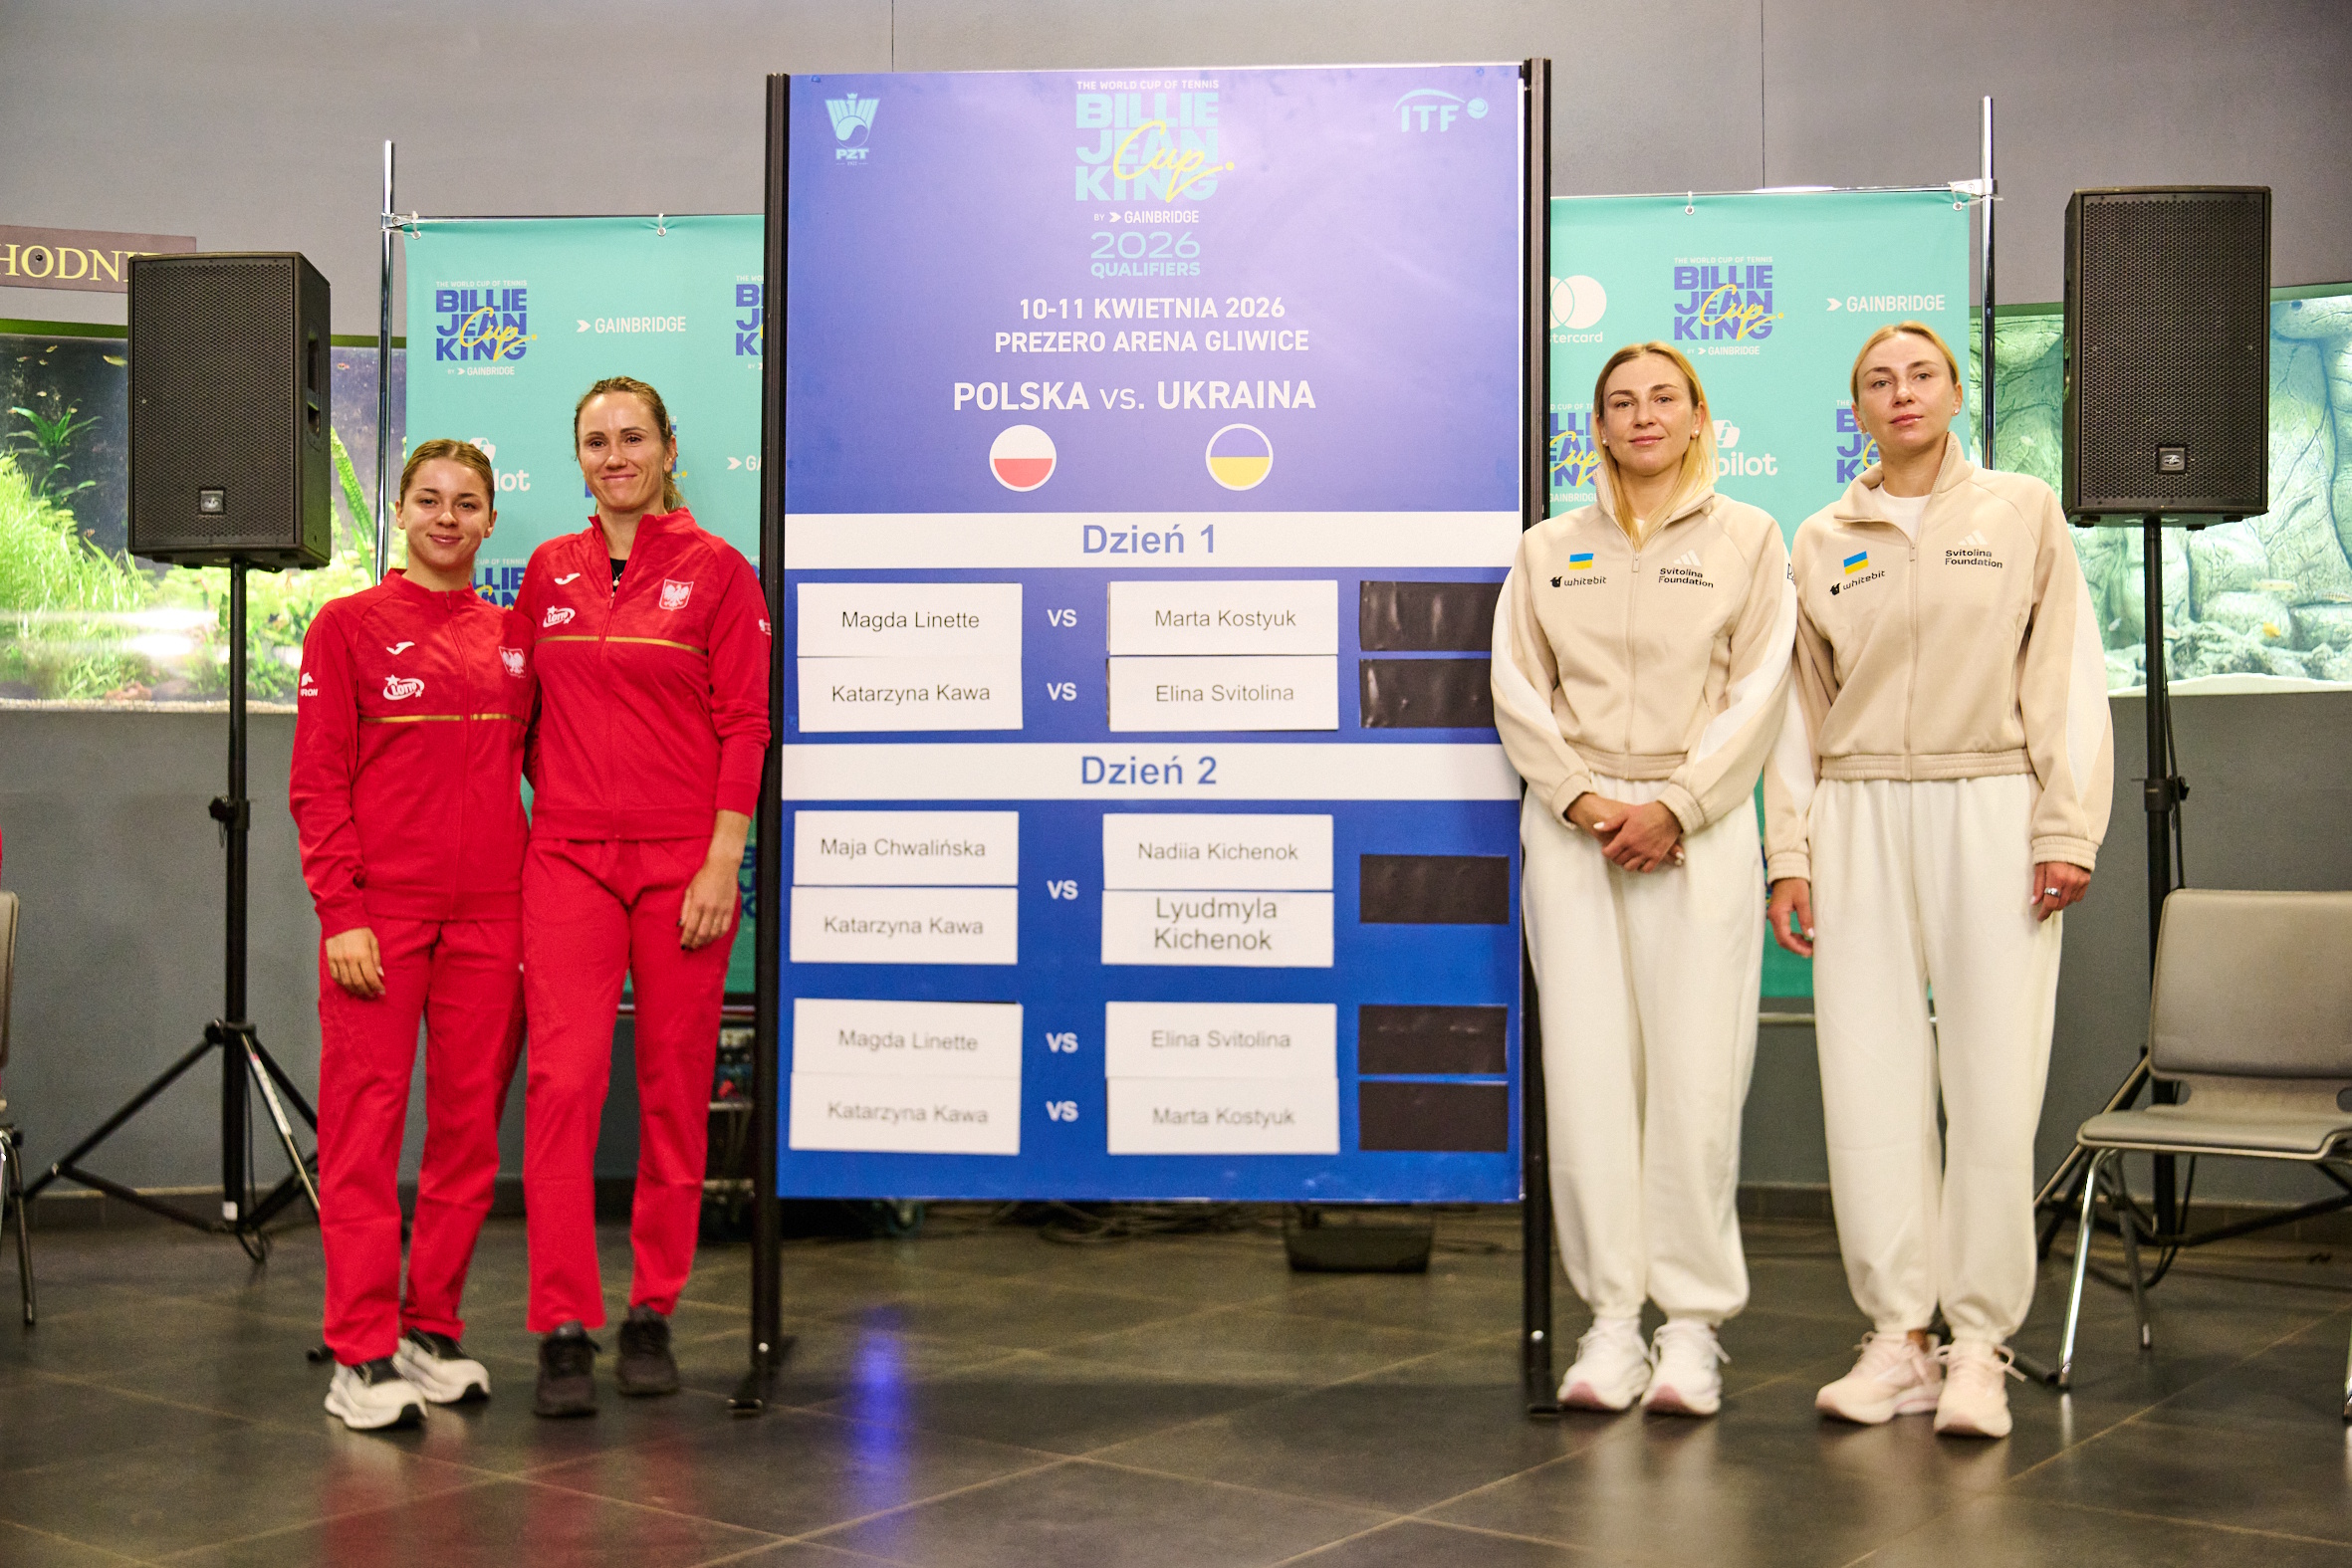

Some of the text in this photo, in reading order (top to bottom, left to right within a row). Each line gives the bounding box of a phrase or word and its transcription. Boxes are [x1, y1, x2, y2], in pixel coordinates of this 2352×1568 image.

[1076, 80, 1219, 90] THE WORLD CUP OF TENNIS
[1075, 92, 1219, 128] BILLIE
[1401, 105, 1460, 132] ITF
[836, 148, 869, 159] PZT
[1075, 129, 1218, 164] JEAN
[1112, 119, 1225, 203] Cup
[1075, 165, 1218, 202] KING
[1124, 211, 1199, 224] GAINBRIDGE
[1090, 231, 1201, 259] 2026
[1090, 262, 1201, 280] QUALIFIERS
[1674, 265, 1772, 290] BILLIE
[436, 289, 528, 313] BILLIE
[1020, 297, 1286, 320] 10-11 KWIETNIA 2026
[1674, 290, 1772, 315] JEAN
[1846, 294, 1946, 313] GAINBRIDGE
[436, 313, 527, 336] JEAN
[594, 316, 686, 334] GAINBRIDGE
[1674, 316, 1772, 340] KING
[995, 330, 1309, 353] PREZERO ARENA GLIWICE
[1550, 331, 1603, 343] tercard
[436, 337, 527, 360] KING
[1708, 345, 1761, 356] GAINBRIDGE
[467, 366, 515, 376] GAINBRIDGE
[953, 381, 1090, 411] POLSKA
[1157, 379, 1316, 410] UKRAINA
[1082, 524, 1215, 554] Dzień 1
[1659, 567, 1704, 578] Svitolina
[1946, 558, 2003, 568] Foundation
[1564, 576, 1606, 587] whitebit
[1658, 575, 1714, 589] Foundation
[1842, 570, 1886, 591] whitebit
[841, 611, 980, 632] Magda Linette
[1155, 609, 1296, 631] Marta Kostyuk
[831, 684, 991, 706] Katarzyna Kawa
[1155, 683, 1294, 702] Elina Svitolina
[1081, 756, 1217, 784] Dzień 2
[821, 837, 986, 859] Maja Chwalińska
[1138, 842, 1298, 861] Nadiia Kichenok
[1155, 896, 1277, 924] Lyudmyla
[823, 916, 984, 938] Katarzyna Kawa
[1154, 928, 1273, 951] Kichenok
[838, 1029, 978, 1051] Magda Linette
[1151, 1029, 1292, 1048] Elina Svitolina
[827, 1101, 989, 1125] Katarzyna Kawa
[1152, 1107, 1295, 1129] Marta Kostyuk
